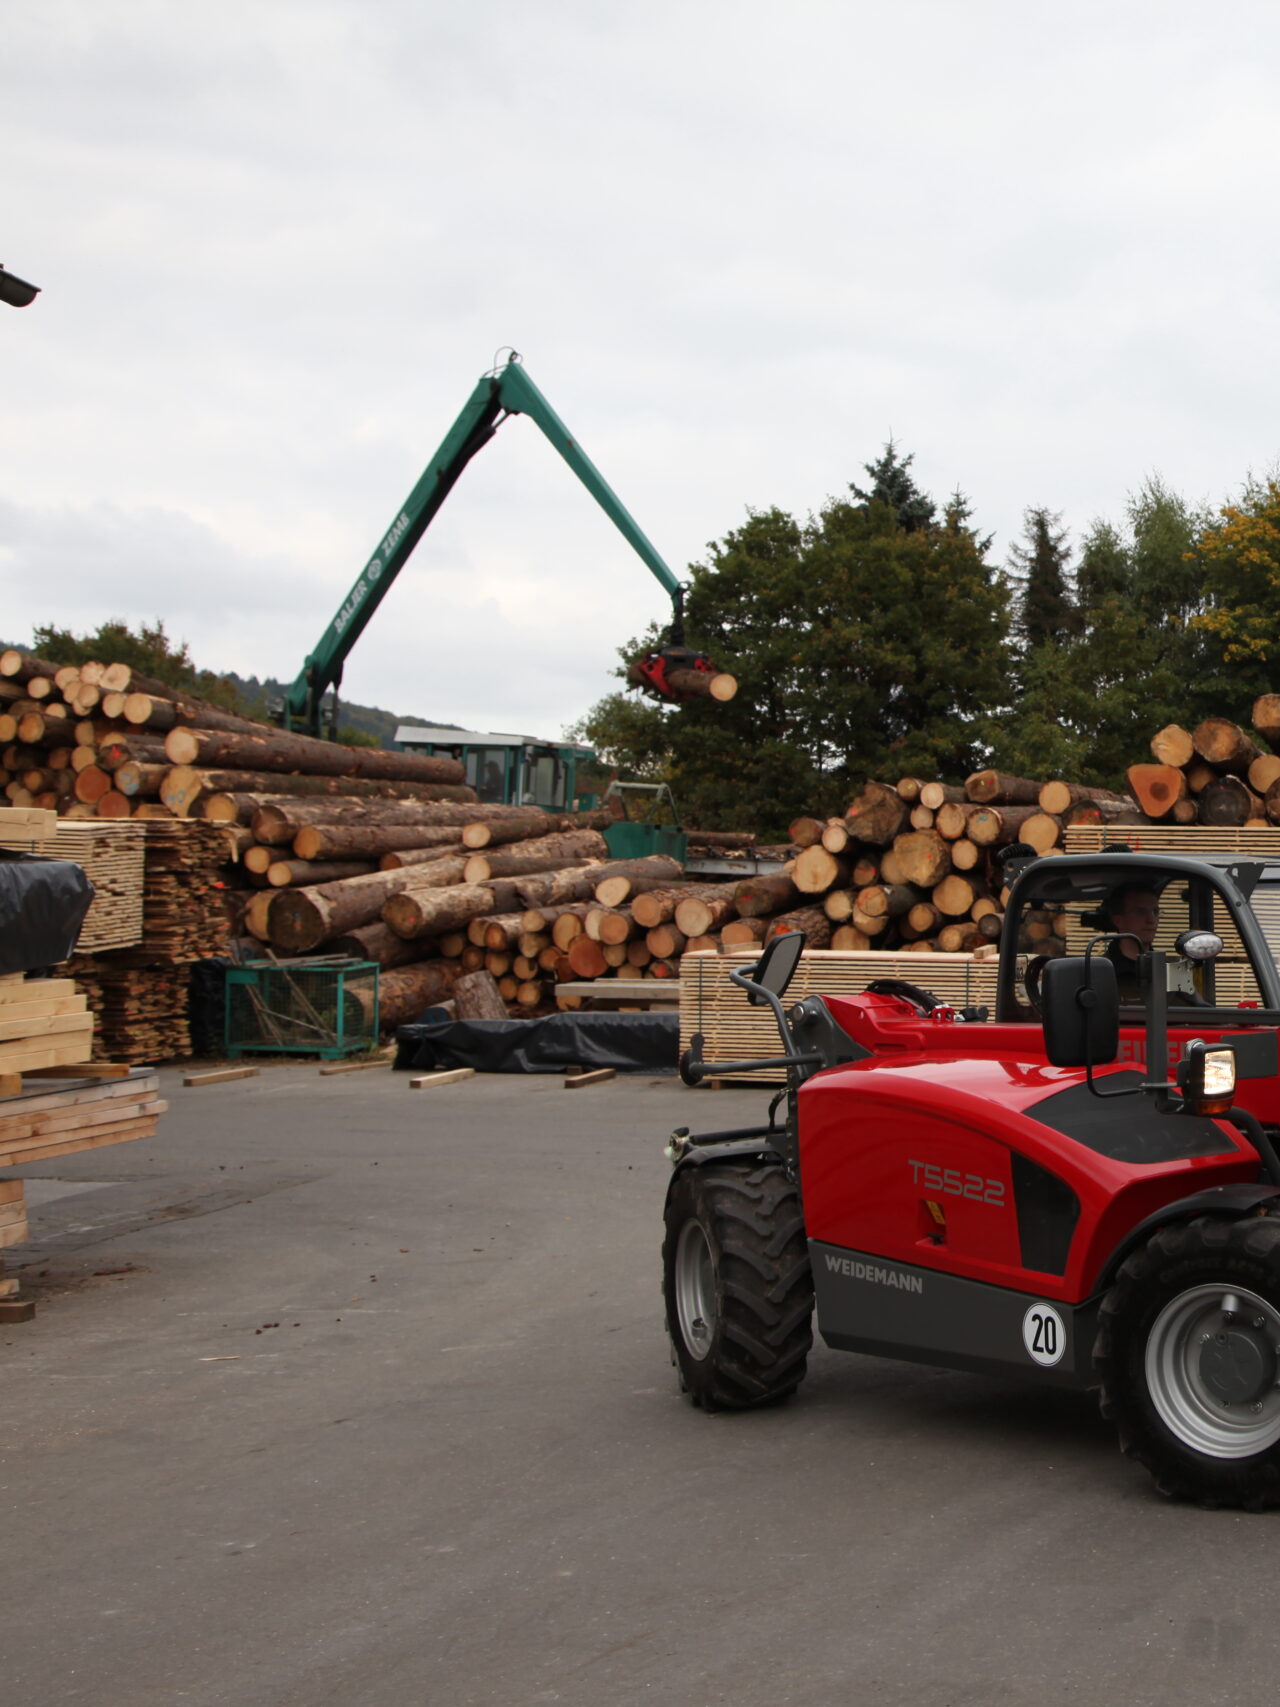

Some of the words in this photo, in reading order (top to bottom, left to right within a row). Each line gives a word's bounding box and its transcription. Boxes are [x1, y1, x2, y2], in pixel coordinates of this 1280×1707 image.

[907, 1159, 1005, 1207] T5522
[824, 1254, 923, 1294] WEIDEMANN
[1031, 1313, 1057, 1355] 20
